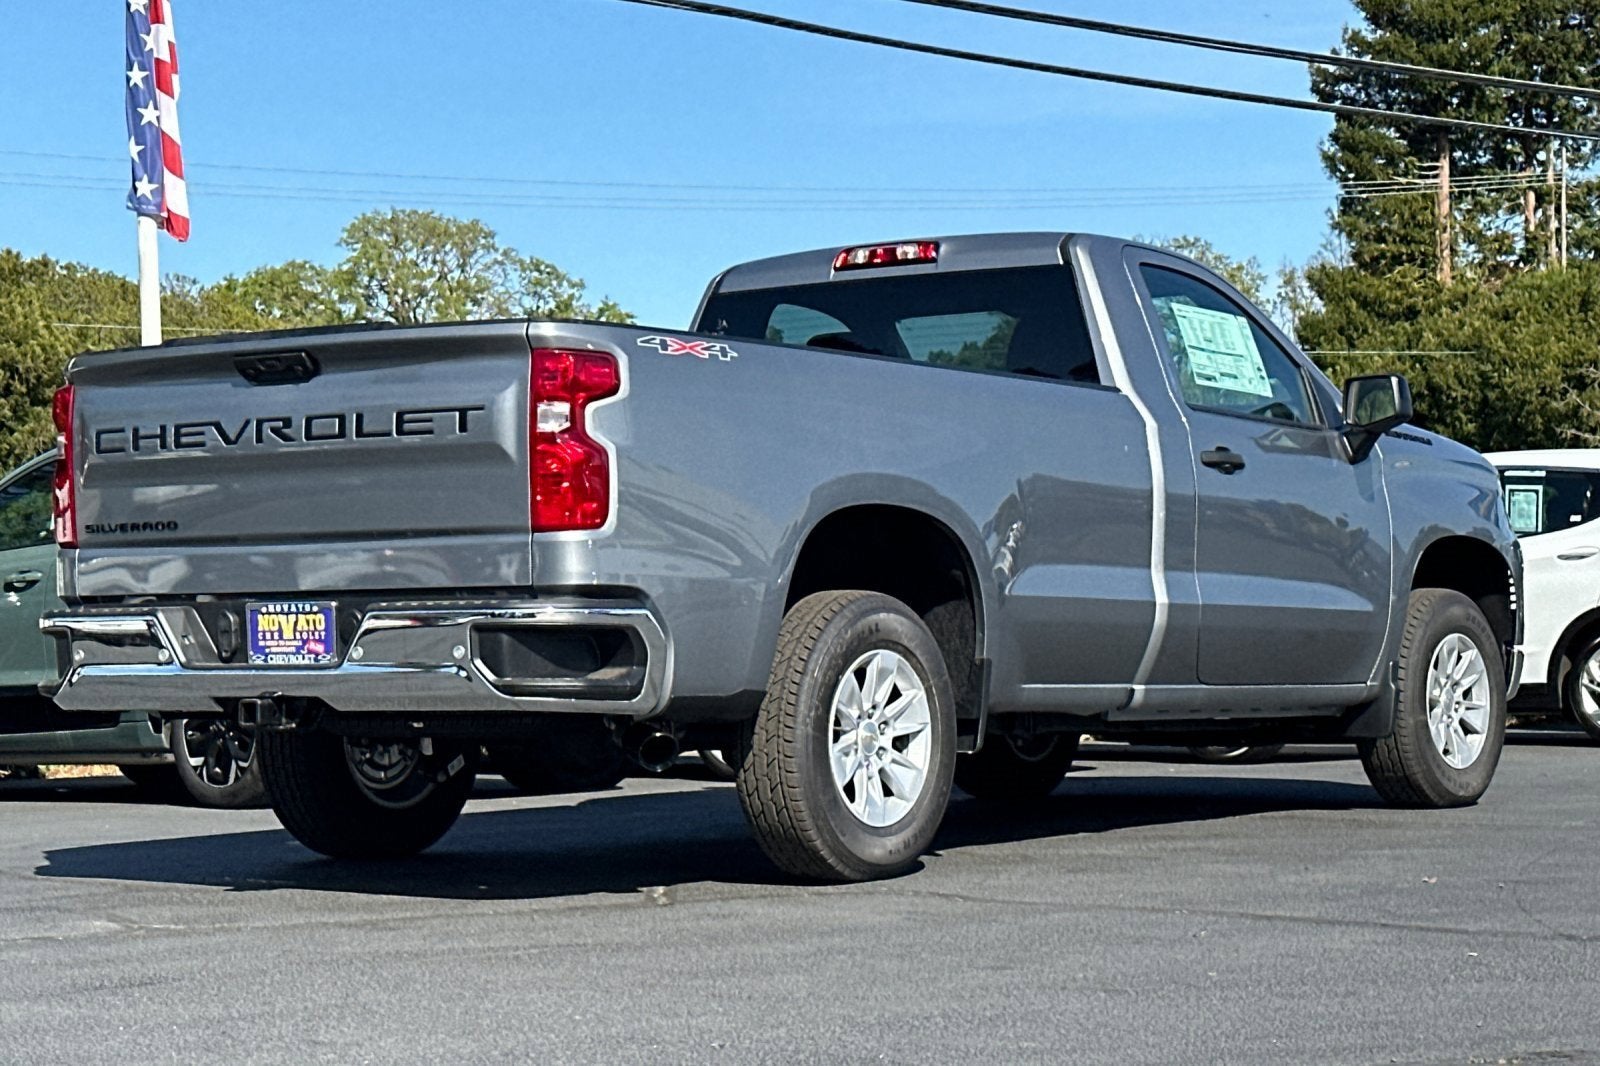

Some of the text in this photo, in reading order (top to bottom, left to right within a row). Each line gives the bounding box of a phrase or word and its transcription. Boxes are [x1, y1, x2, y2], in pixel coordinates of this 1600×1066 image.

[95, 404, 485, 455] CHEVROLET
[84, 520, 178, 534] SILVERADO
[268, 603, 311, 612] NOVATO
[257, 613, 325, 640] NOVATO
[267, 654, 316, 664] CHEVROLET
